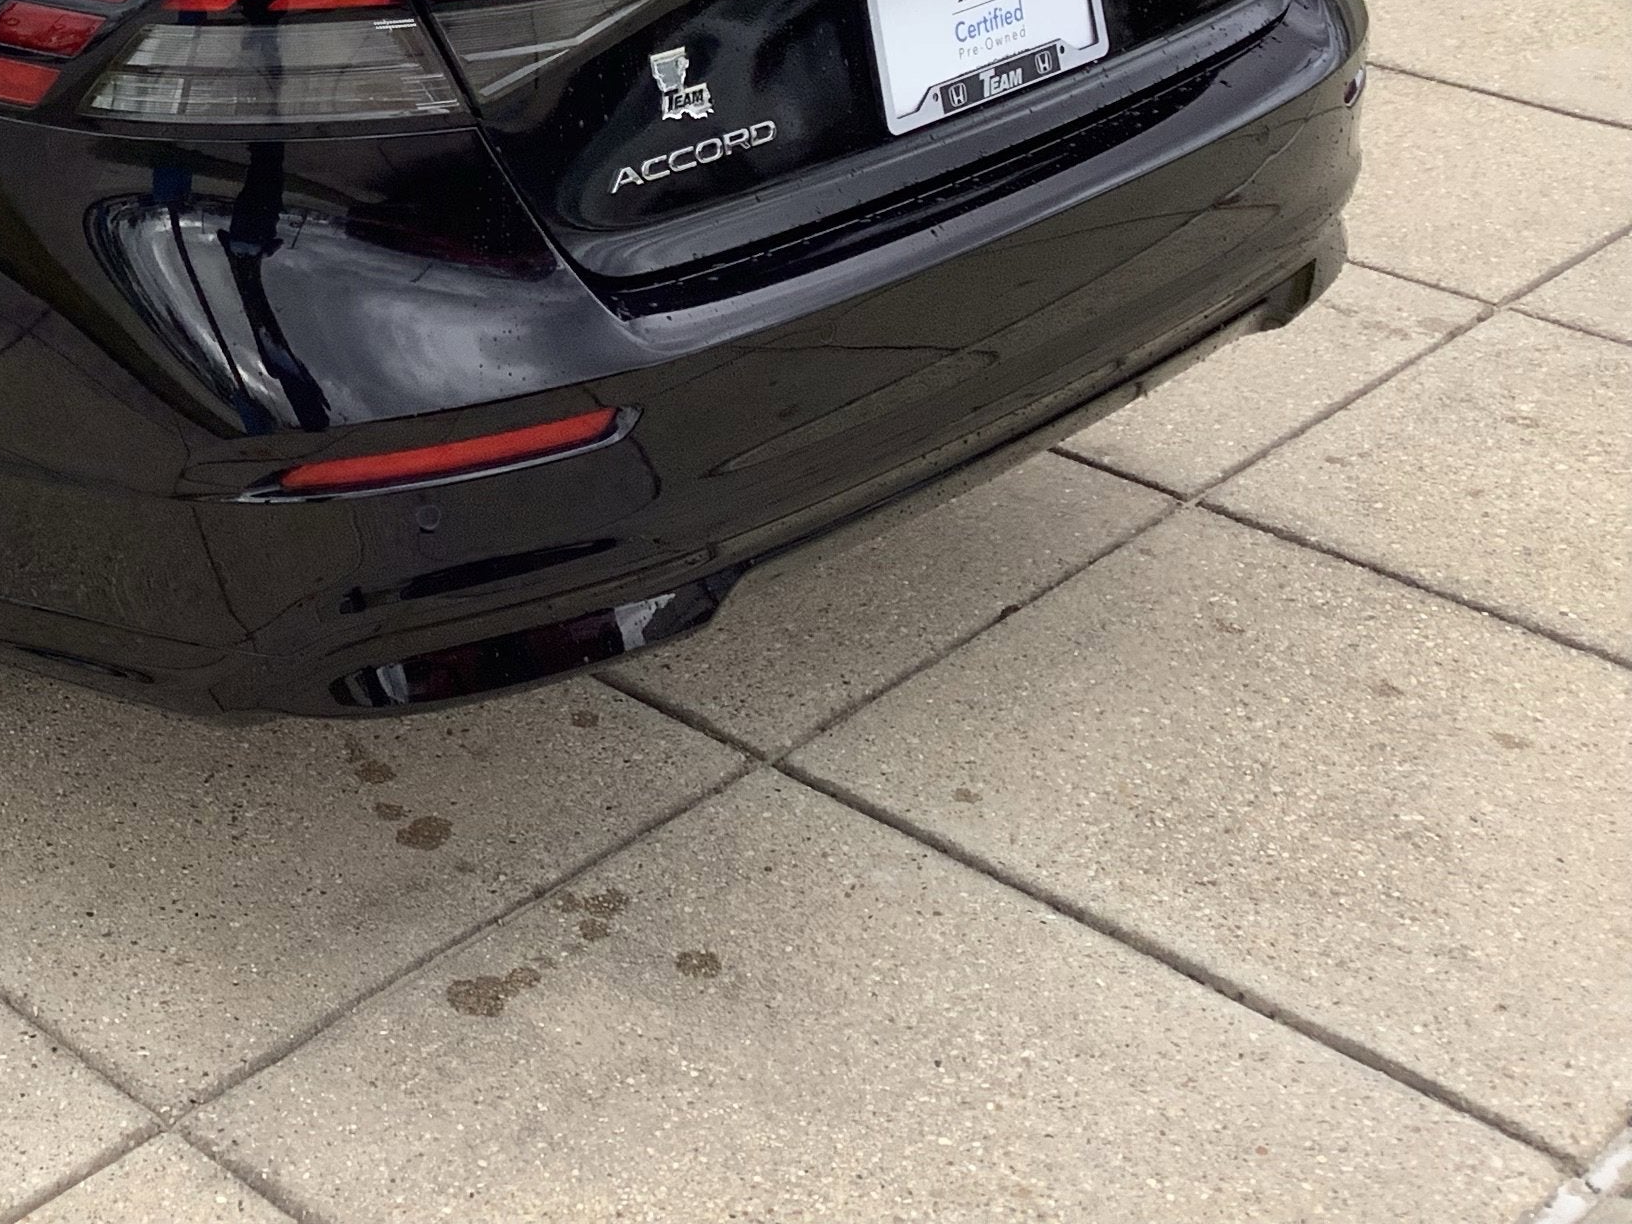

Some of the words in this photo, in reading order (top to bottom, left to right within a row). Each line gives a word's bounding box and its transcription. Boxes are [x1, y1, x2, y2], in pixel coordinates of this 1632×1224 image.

[954, 0, 1025, 43] Certified
[958, 24, 1027, 60] Pre-Owned
[664, 88, 704, 111] TEAM
[979, 67, 1023, 98] TEAM
[610, 120, 778, 194] ACCORD
